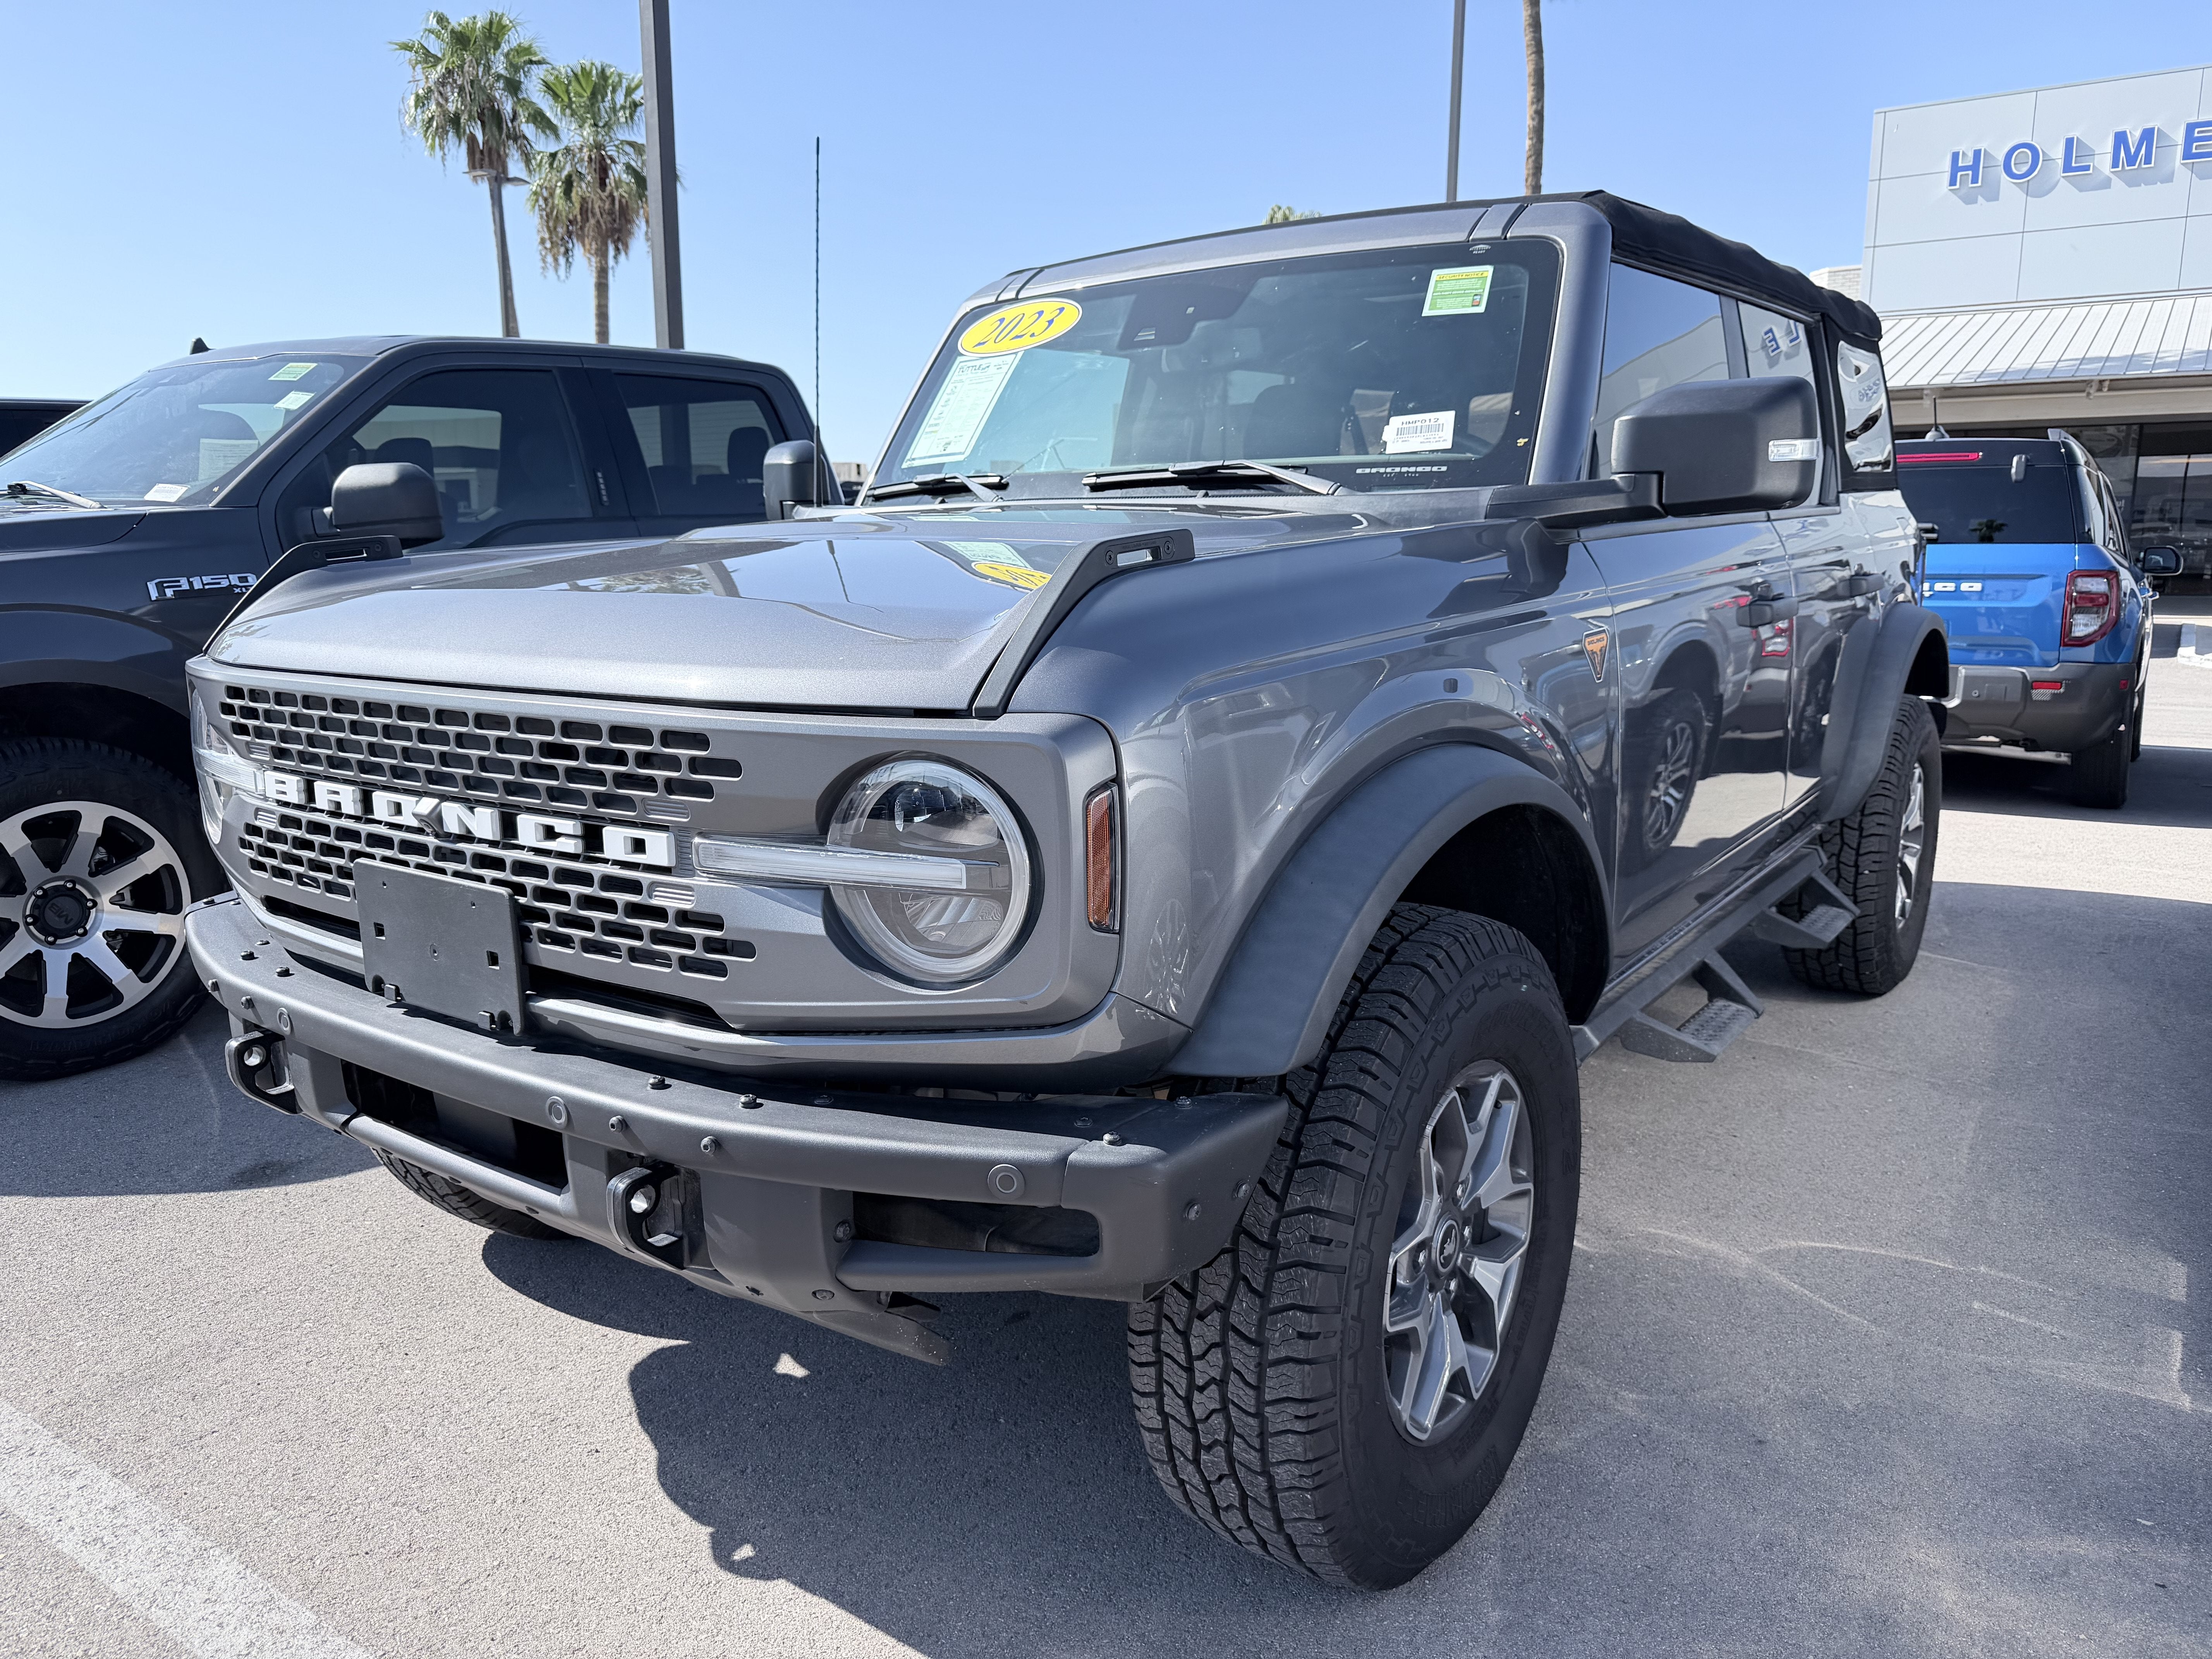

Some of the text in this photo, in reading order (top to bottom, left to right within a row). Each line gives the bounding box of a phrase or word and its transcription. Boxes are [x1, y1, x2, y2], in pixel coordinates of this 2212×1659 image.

[1947, 119, 2212, 189] HOLME
[972, 307, 1065, 348] 2023
[958, 364, 984, 374] TUTTLE
[264, 769, 676, 867] BRONCO
